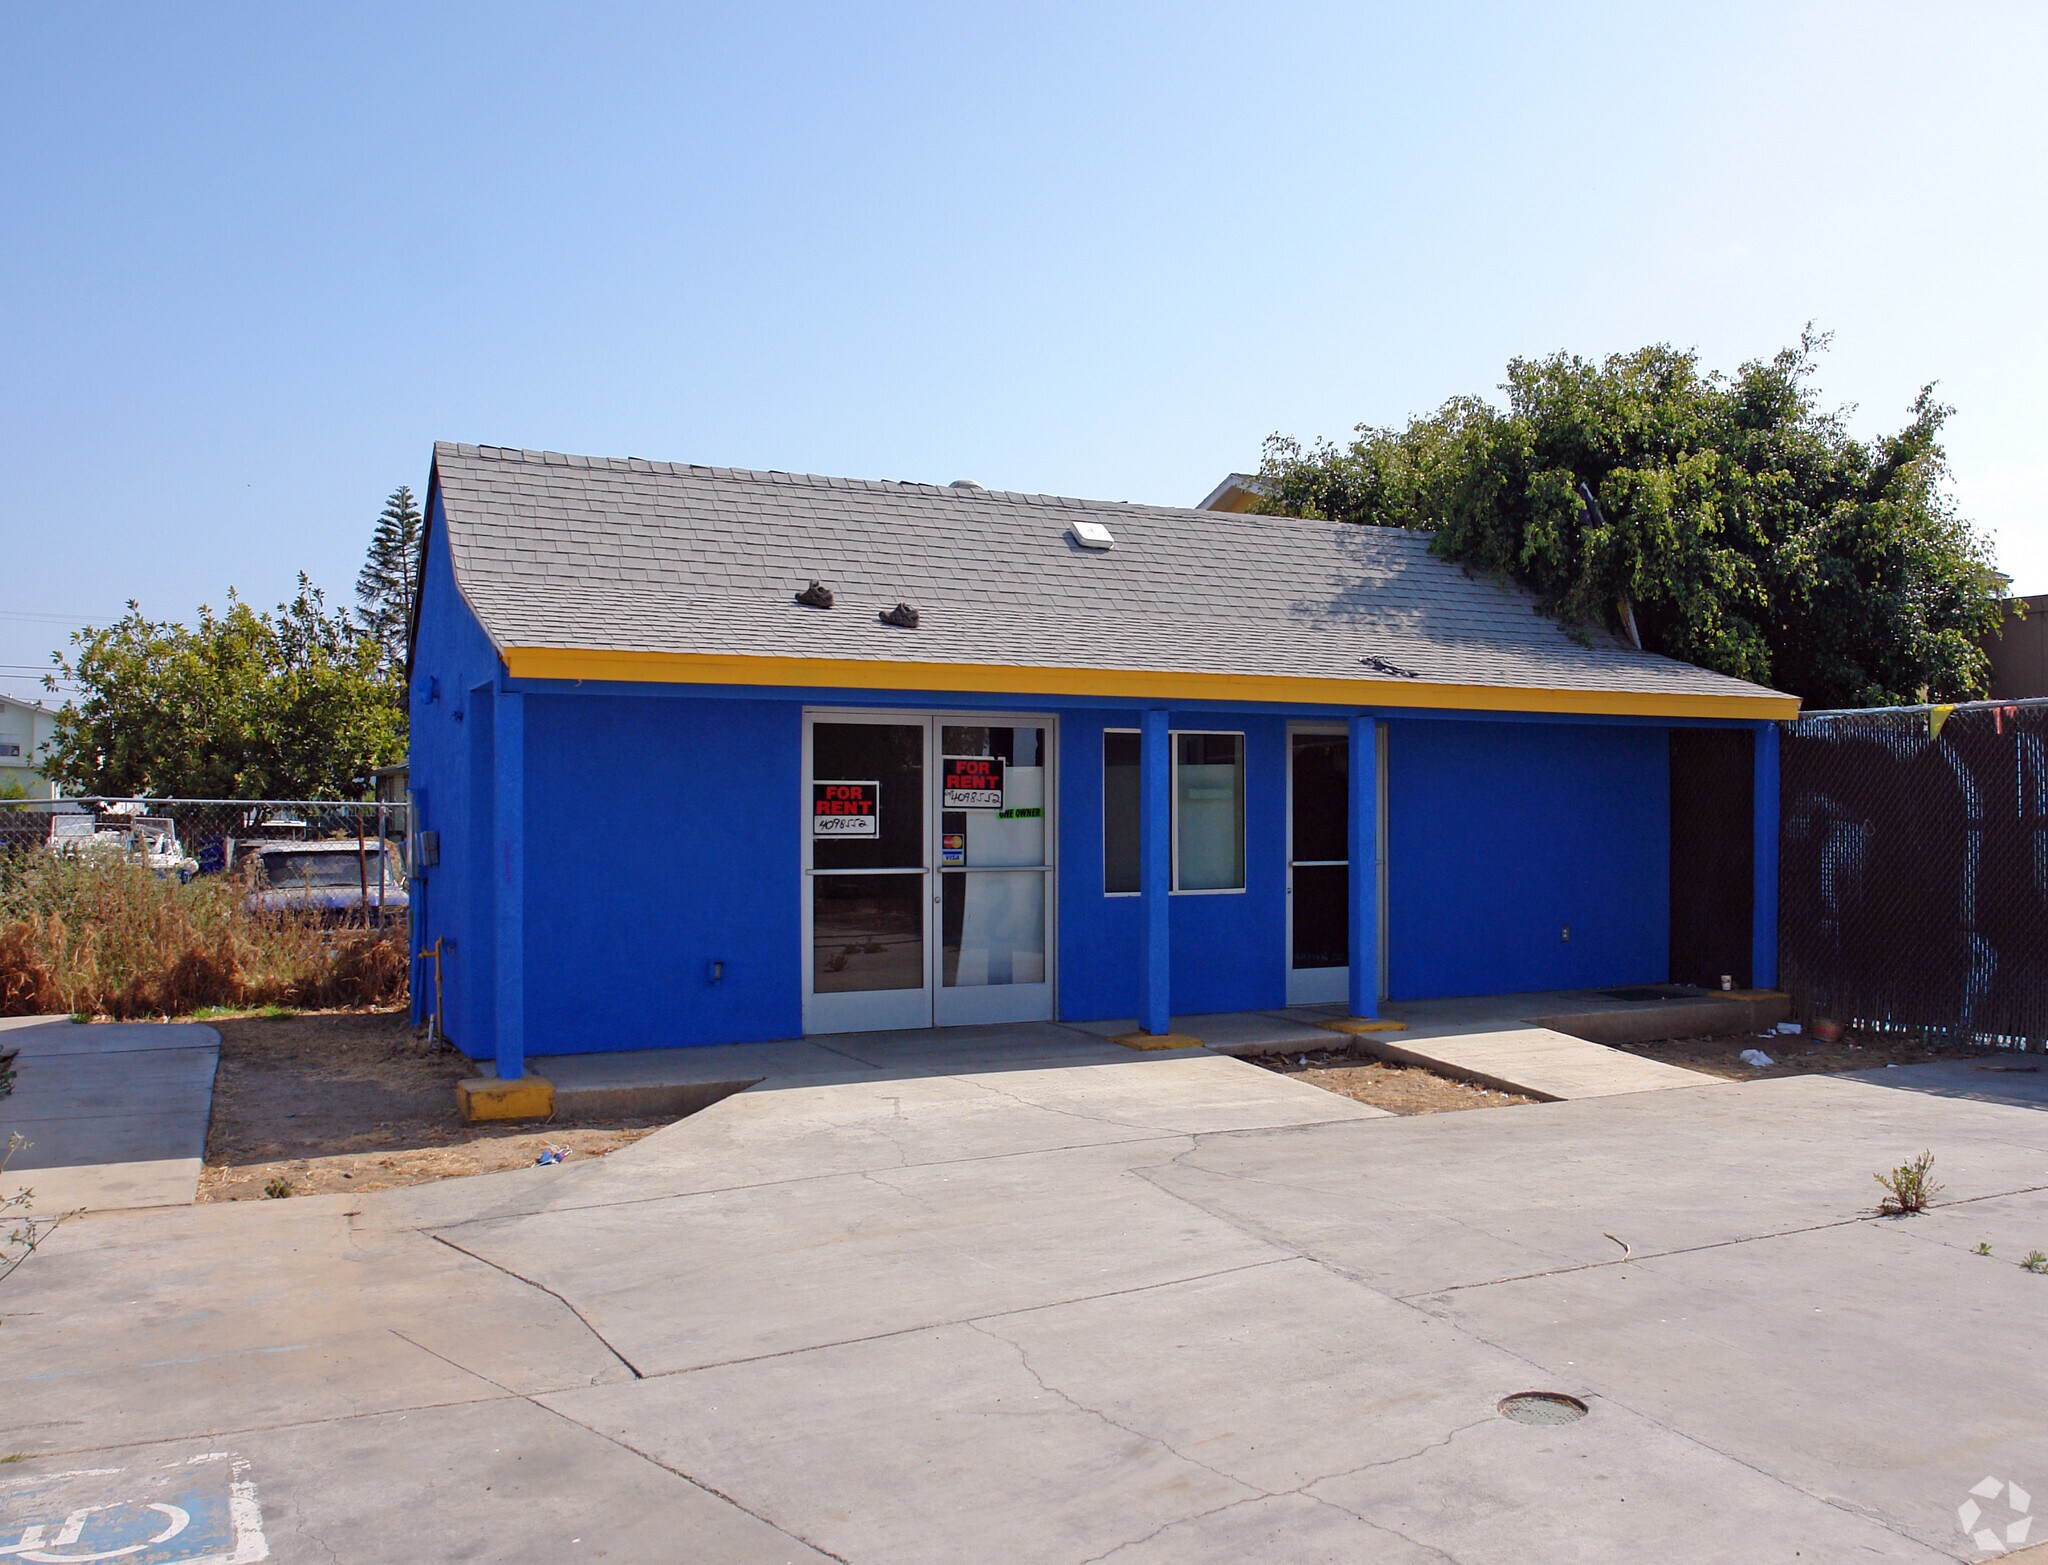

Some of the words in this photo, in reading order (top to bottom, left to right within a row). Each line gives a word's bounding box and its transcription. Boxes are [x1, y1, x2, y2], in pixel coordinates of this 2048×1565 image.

[957, 761, 990, 774] FOR
[947, 775, 999, 789] RENT
[827, 786, 862, 800] FOR
[951, 792, 1001, 803] 4098552
[816, 801, 872, 815] RENT
[1016, 808, 1040, 818] OWNER
